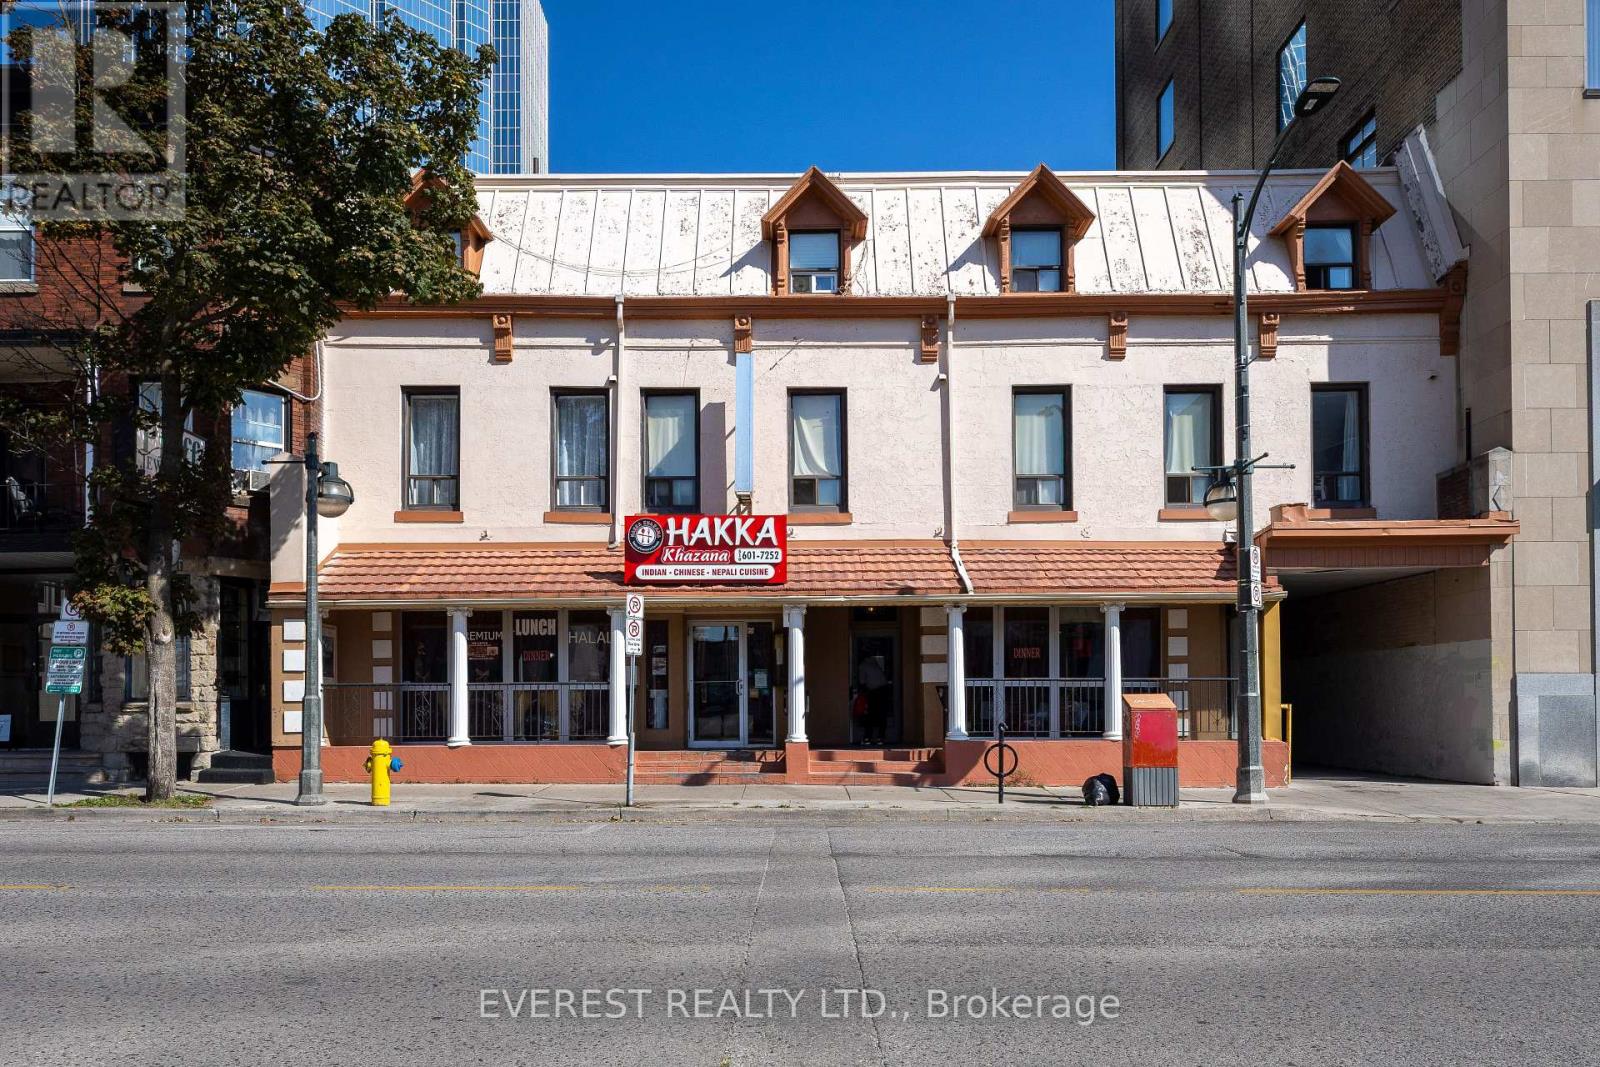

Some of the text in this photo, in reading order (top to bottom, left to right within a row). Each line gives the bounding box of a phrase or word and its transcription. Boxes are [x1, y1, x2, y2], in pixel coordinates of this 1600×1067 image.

[666, 517, 778, 546] HAKKA
[662, 546, 730, 562] Khazana
[742, 550, 779, 560] 601-7252
[641, 568, 769, 576] INDIAN CHINESE NEPALI CUISINE
[515, 618, 556, 636] LUNCH
[464, 631, 503, 641] REMIUM
[1013, 647, 1041, 659] DINNER
